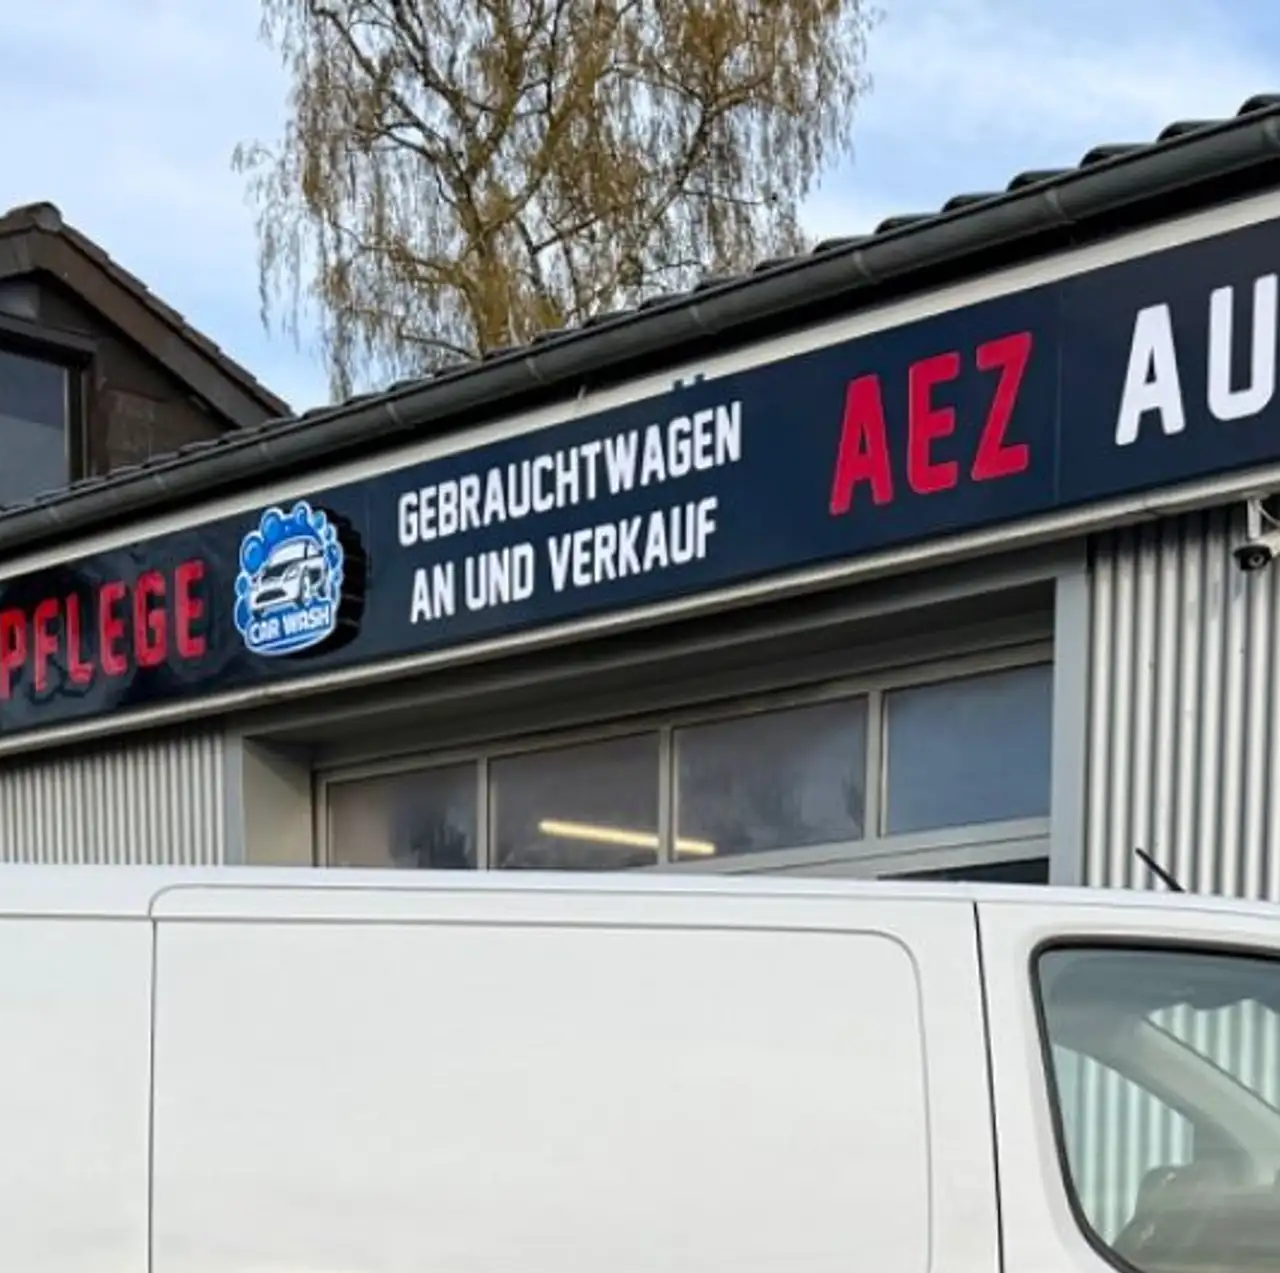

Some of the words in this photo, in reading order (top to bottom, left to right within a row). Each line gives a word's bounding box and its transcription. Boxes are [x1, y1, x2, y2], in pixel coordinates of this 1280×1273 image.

[398, 401, 742, 547] GEBRAUCHTWAGEN
[829, 331, 1033, 515] AEZ
[250, 618, 280, 644] CAR
[282, 602, 330, 635] WASH
[410, 568, 454, 624] AN
[466, 546, 533, 612] UND
[548, 498, 718, 590] VERKAUF
